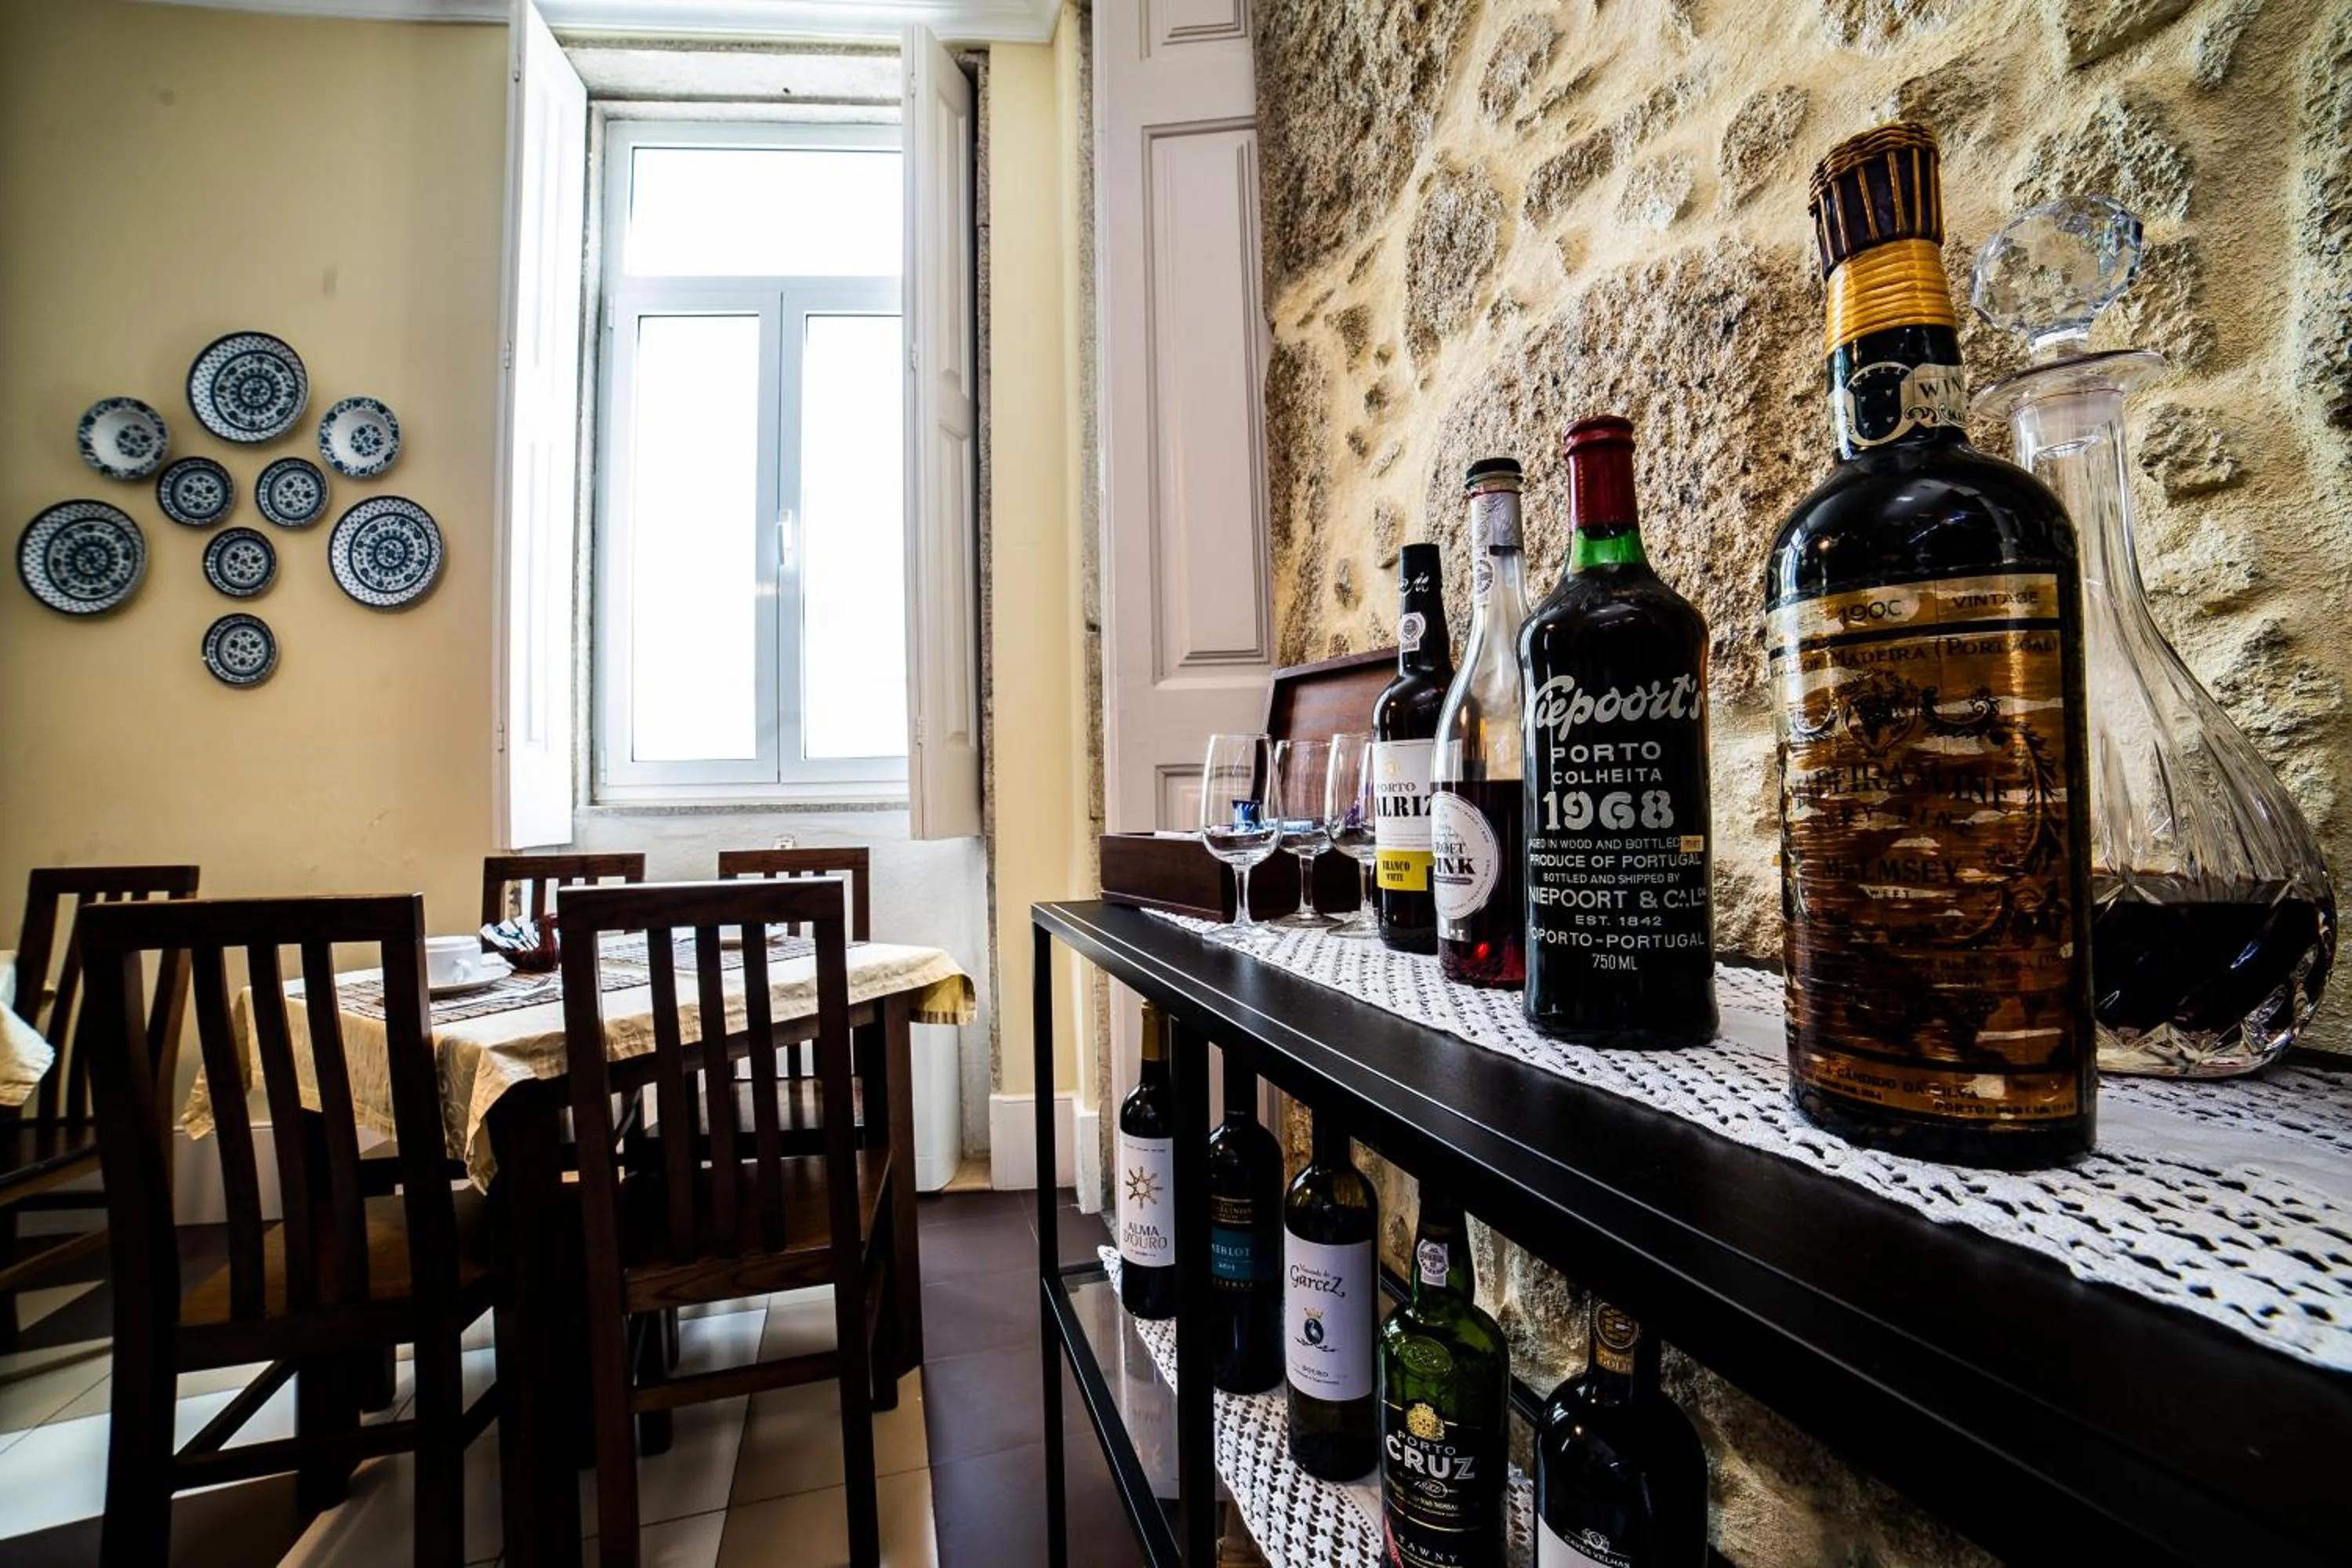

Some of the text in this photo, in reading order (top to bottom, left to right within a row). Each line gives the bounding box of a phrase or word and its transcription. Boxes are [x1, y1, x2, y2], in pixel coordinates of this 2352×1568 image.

[1952, 592, 2038, 610] VINTAGE
[1552, 741, 1662, 764] PORTO
[1552, 768, 1663, 785] COLHEITA
[1542, 789, 1675, 831] 1968
[1548, 839, 1557, 849] IN
[1559, 839, 1592, 850] WOOD
[1595, 839, 1622, 850] AND
[1530, 853, 1702, 869] PRODUCE OF PORTUGAL
[1543, 872, 1680, 884] BOTTLED AND SHIPPED BY
[1529, 886, 1628, 909] NIEPOORT
[1639, 890, 1658, 909] &
[1575, 915, 1663, 927] EST. 1842
[1592, 953, 1638, 970] 750 ML
[1128, 1221, 1160, 1236] ALMA
[1398, 1430, 1456, 1456] PORTO
[1385, 1434, 1475, 1480] CRUZ
[1399, 1534, 1457, 1563] TAWNY
